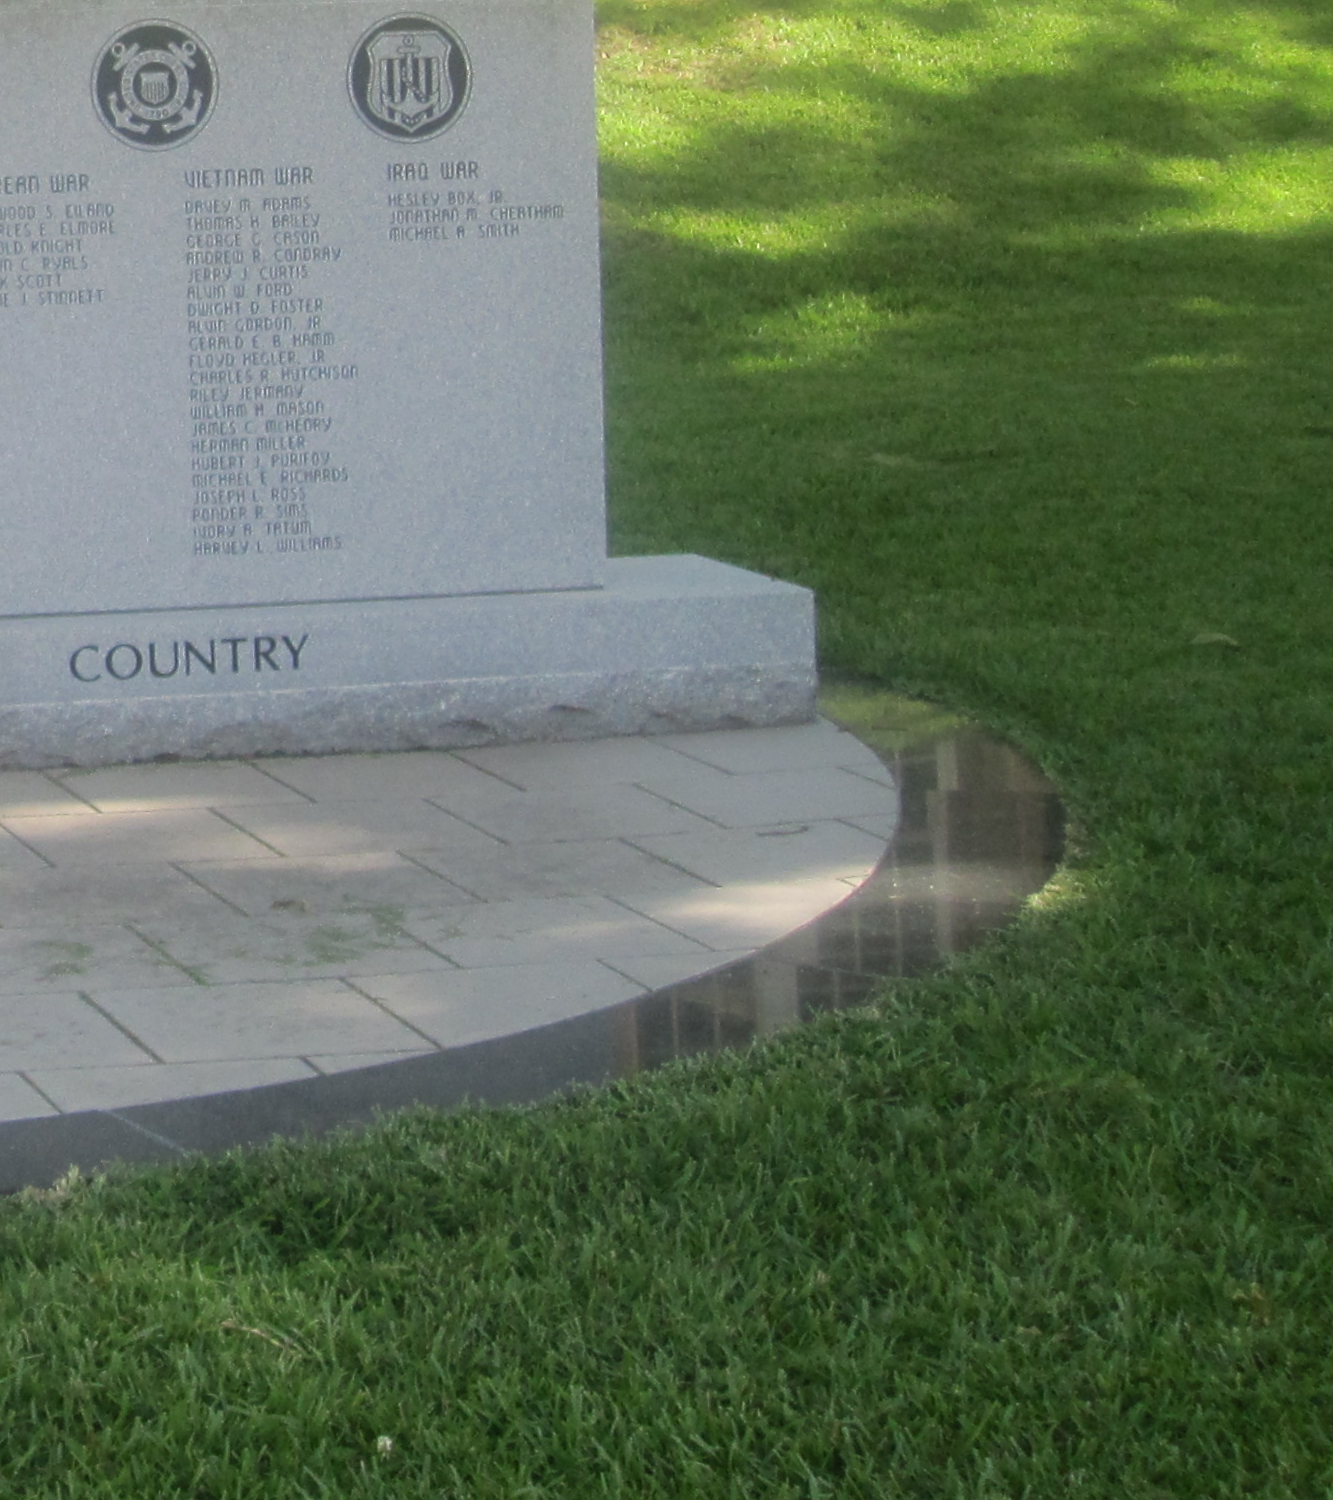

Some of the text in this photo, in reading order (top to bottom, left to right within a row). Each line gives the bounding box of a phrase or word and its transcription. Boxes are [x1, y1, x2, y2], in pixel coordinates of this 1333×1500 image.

[185, 166, 313, 188] VIETNAM WAR
[387, 160, 479, 182] IRAQ WAR
[50, 173, 89, 193] WAR
[187, 212, 320, 231] THOMAS BAILEY
[389, 222, 520, 241] MICHAEL SMITH
[31, 238, 83, 254] KNIGHT
[69, 633, 309, 682] COUNTRY
